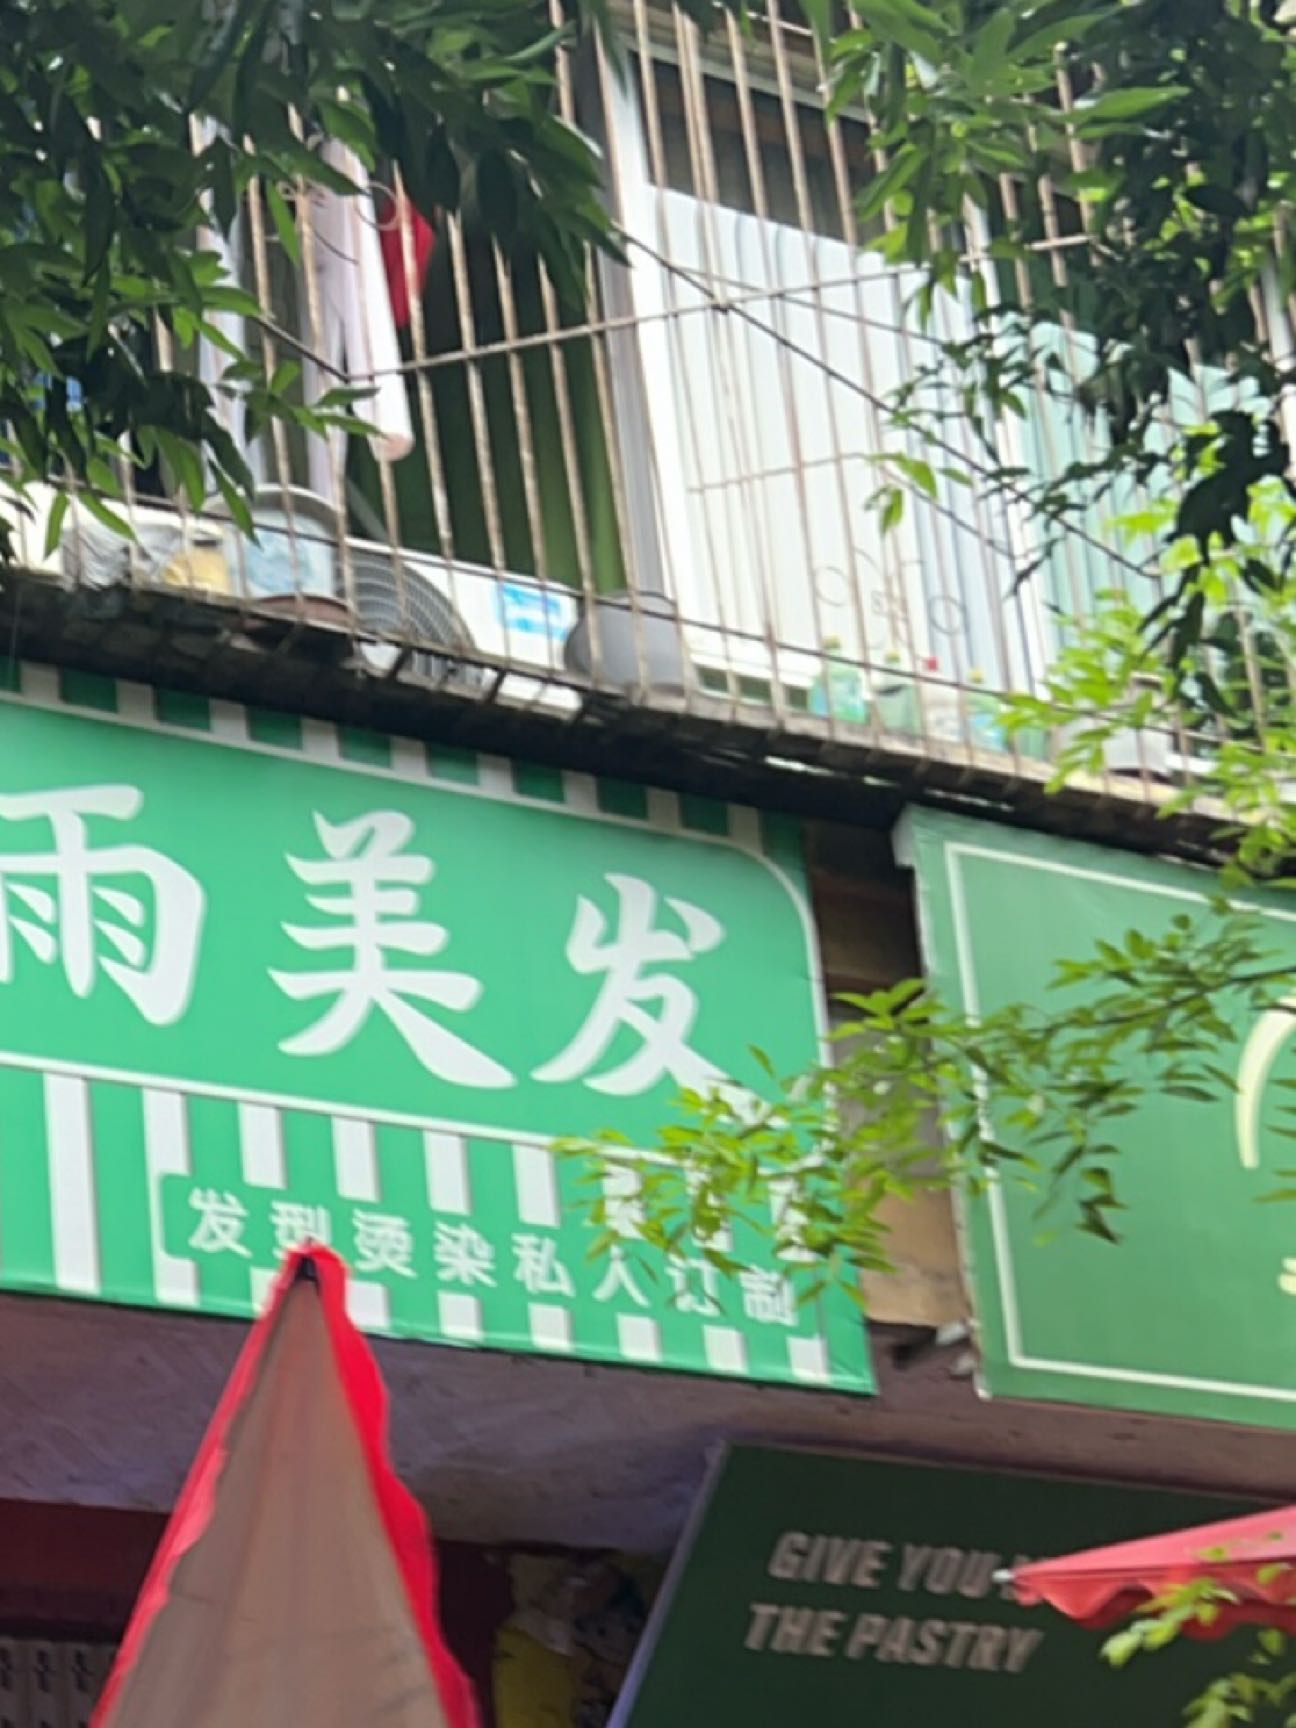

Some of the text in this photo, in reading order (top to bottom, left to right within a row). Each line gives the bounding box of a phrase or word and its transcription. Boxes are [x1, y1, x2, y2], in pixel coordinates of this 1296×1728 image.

[768, 1530, 893, 1588] GIVE
[897, 1543, 1002, 1598] YOU
[744, 1602, 1045, 1674] THE PASTRY
